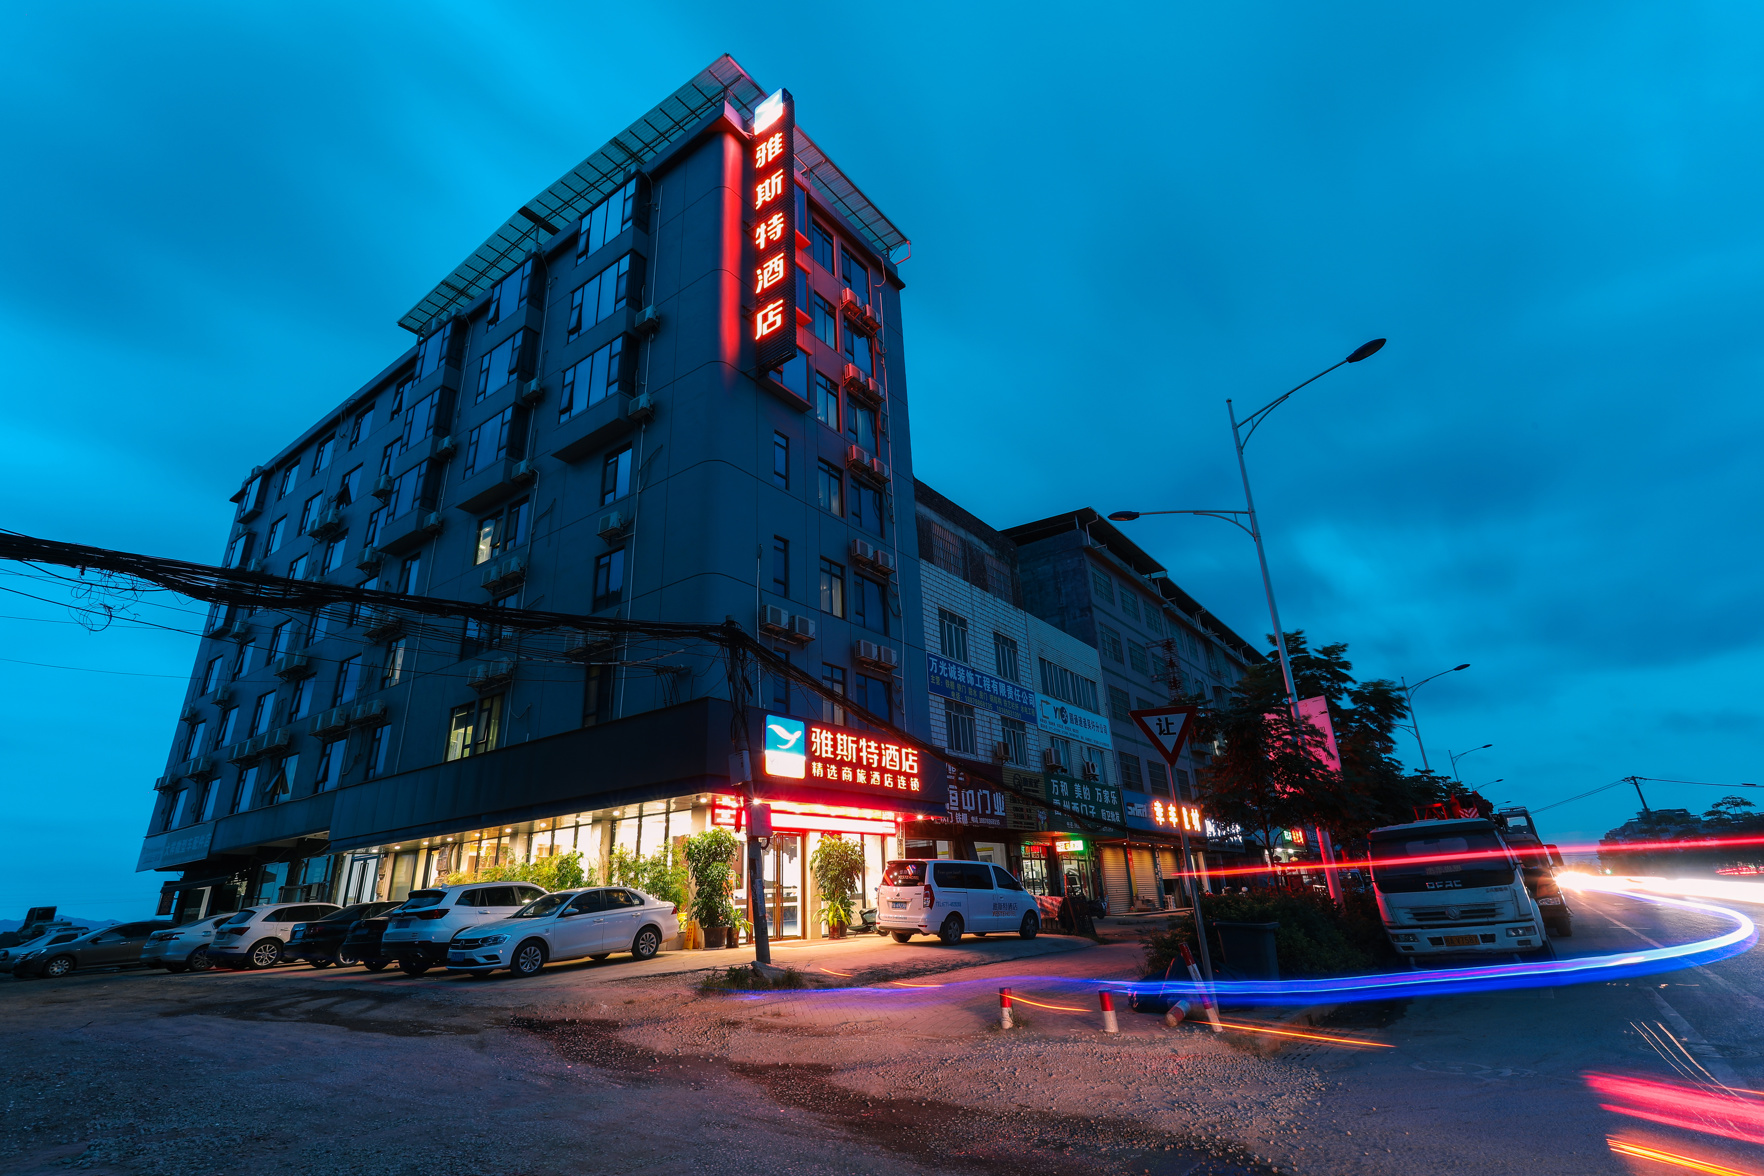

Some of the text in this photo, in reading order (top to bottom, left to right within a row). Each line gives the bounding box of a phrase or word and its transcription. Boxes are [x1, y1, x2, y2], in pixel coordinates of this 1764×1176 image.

[755, 132, 784, 341] 雅斯特酒店
[1156, 717, 1176, 736] 让
[811, 727, 919, 774] 雅斯特酒店
[812, 761, 920, 792] 精选商旅酒店连锁
[1050, 779, 1069, 797] 万和
[1074, 782, 1091, 801] 美的
[1095, 787, 1118, 806] 万家乐
[1425, 879, 1462, 889] DFAC
